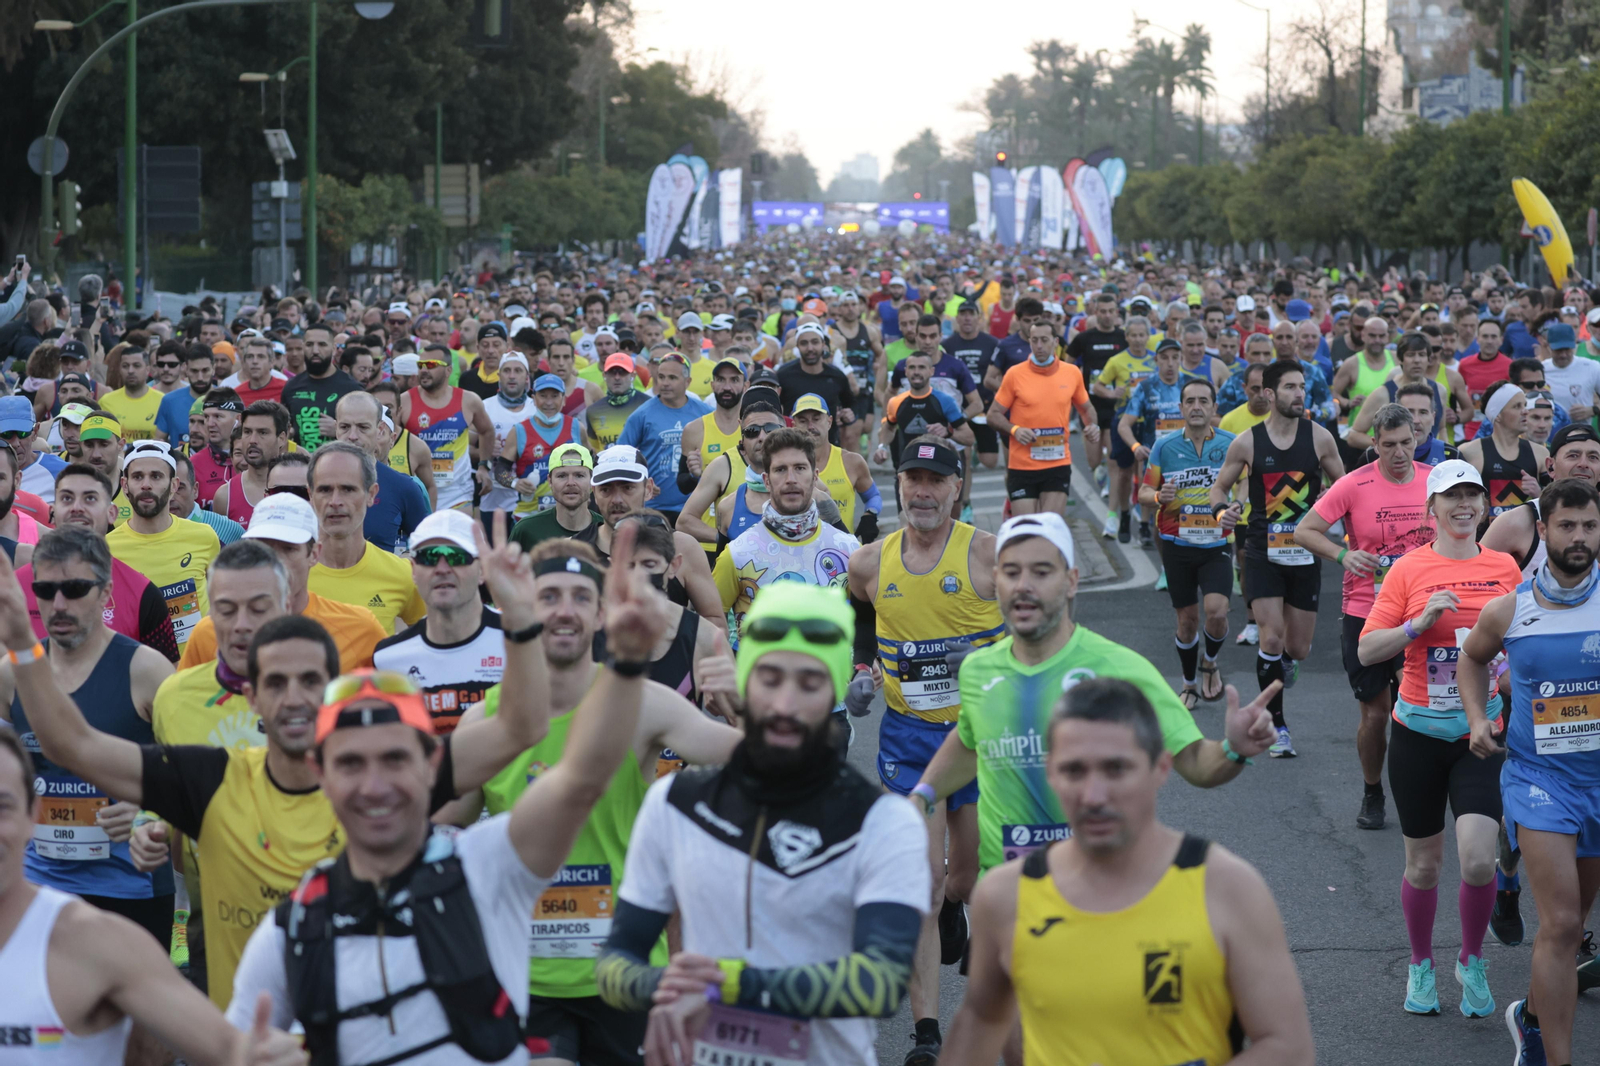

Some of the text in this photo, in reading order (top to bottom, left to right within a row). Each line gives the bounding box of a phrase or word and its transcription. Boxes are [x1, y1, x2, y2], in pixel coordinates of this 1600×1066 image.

[300, 406, 322, 453] PARIS
[418, 431, 459, 441] PALACIEGO
[1185, 467, 1211, 479] TRAIL
[1178, 478, 1204, 489] TEAM
[921, 663, 948, 677] 2943
[923, 681, 951, 692] MIXTO
[1560, 704, 1588, 717] 4854
[48, 782, 97, 795] ZURICH
[50, 807, 76, 821] 3421
[53, 829, 75, 840] CIRO
[541, 898, 578, 914] 5640
